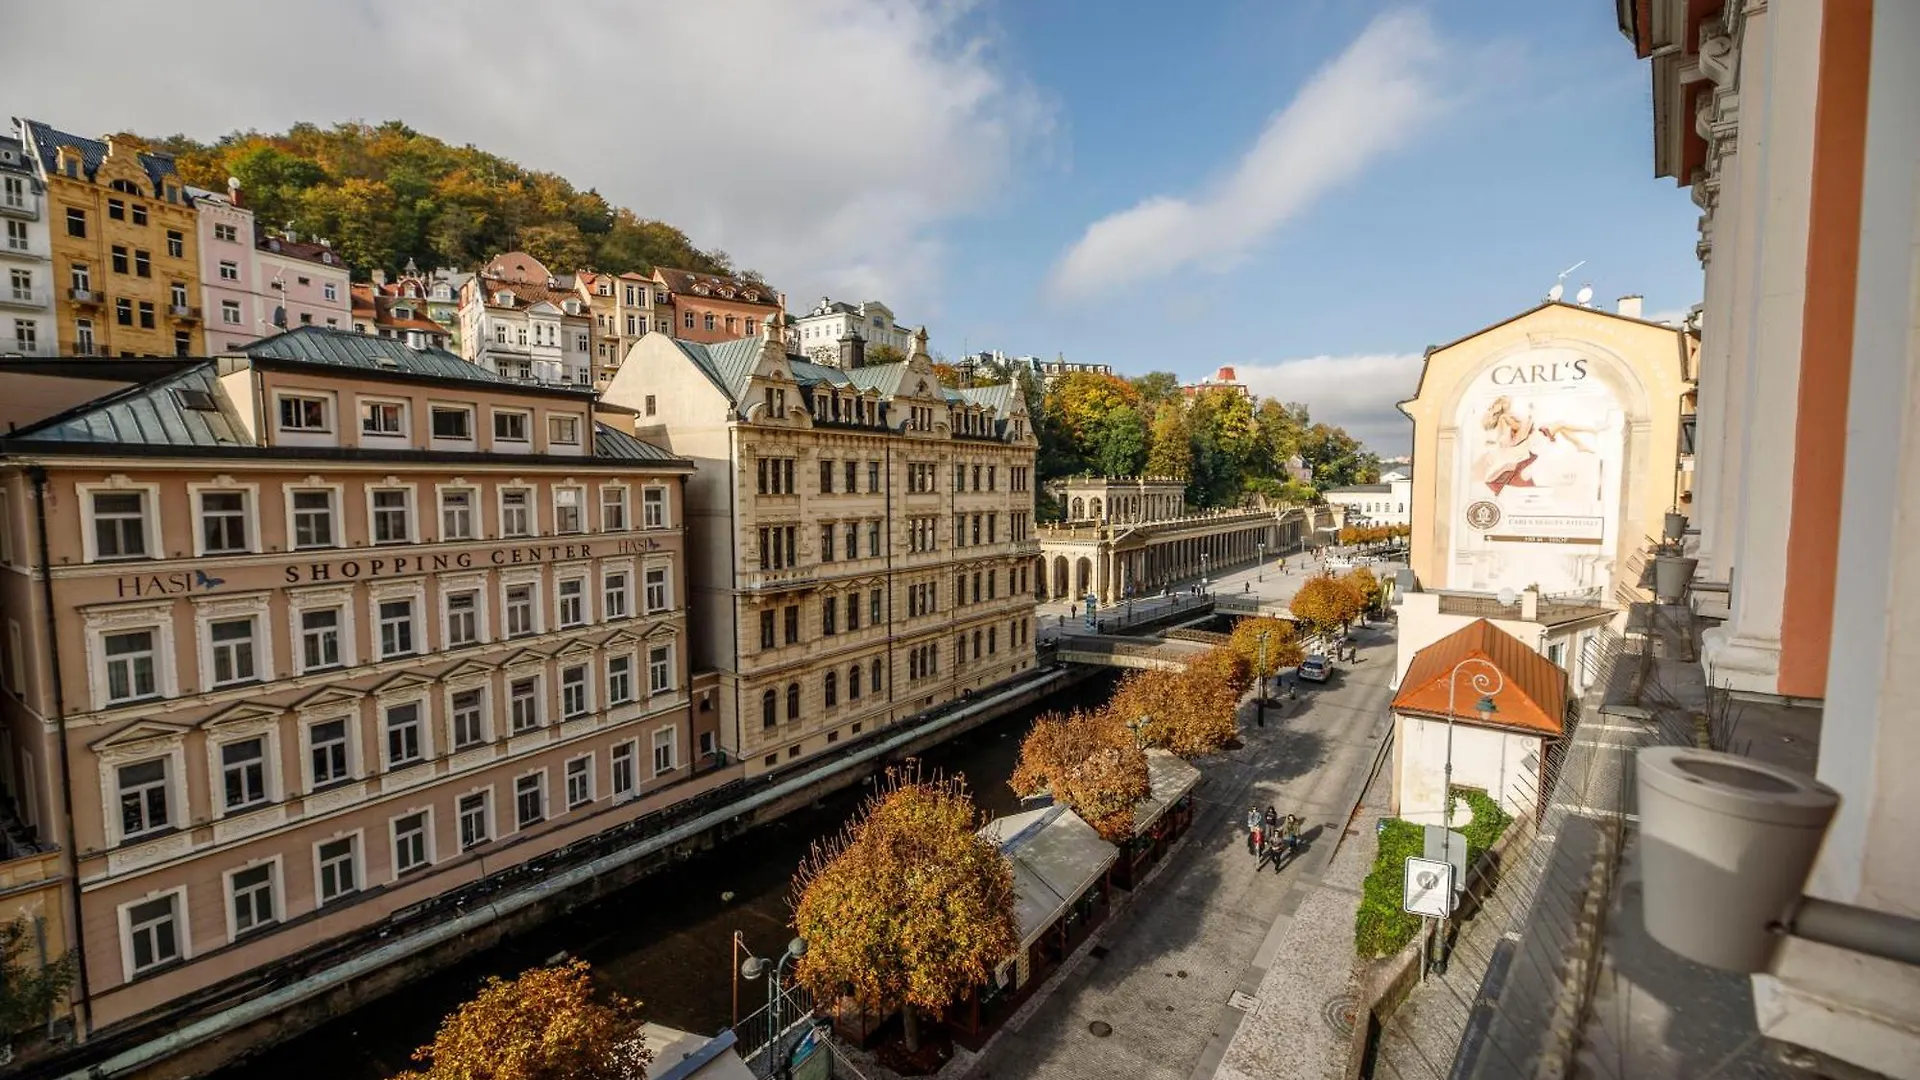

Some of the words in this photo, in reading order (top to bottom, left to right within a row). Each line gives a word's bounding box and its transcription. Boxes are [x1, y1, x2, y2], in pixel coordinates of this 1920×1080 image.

[1490, 358, 1588, 385] CARL'S
[618, 539, 648, 555] HASI
[285, 552, 472, 583] SHOPPING
[490, 544, 593, 565] CENTER
[117, 572, 192, 598] HASI
